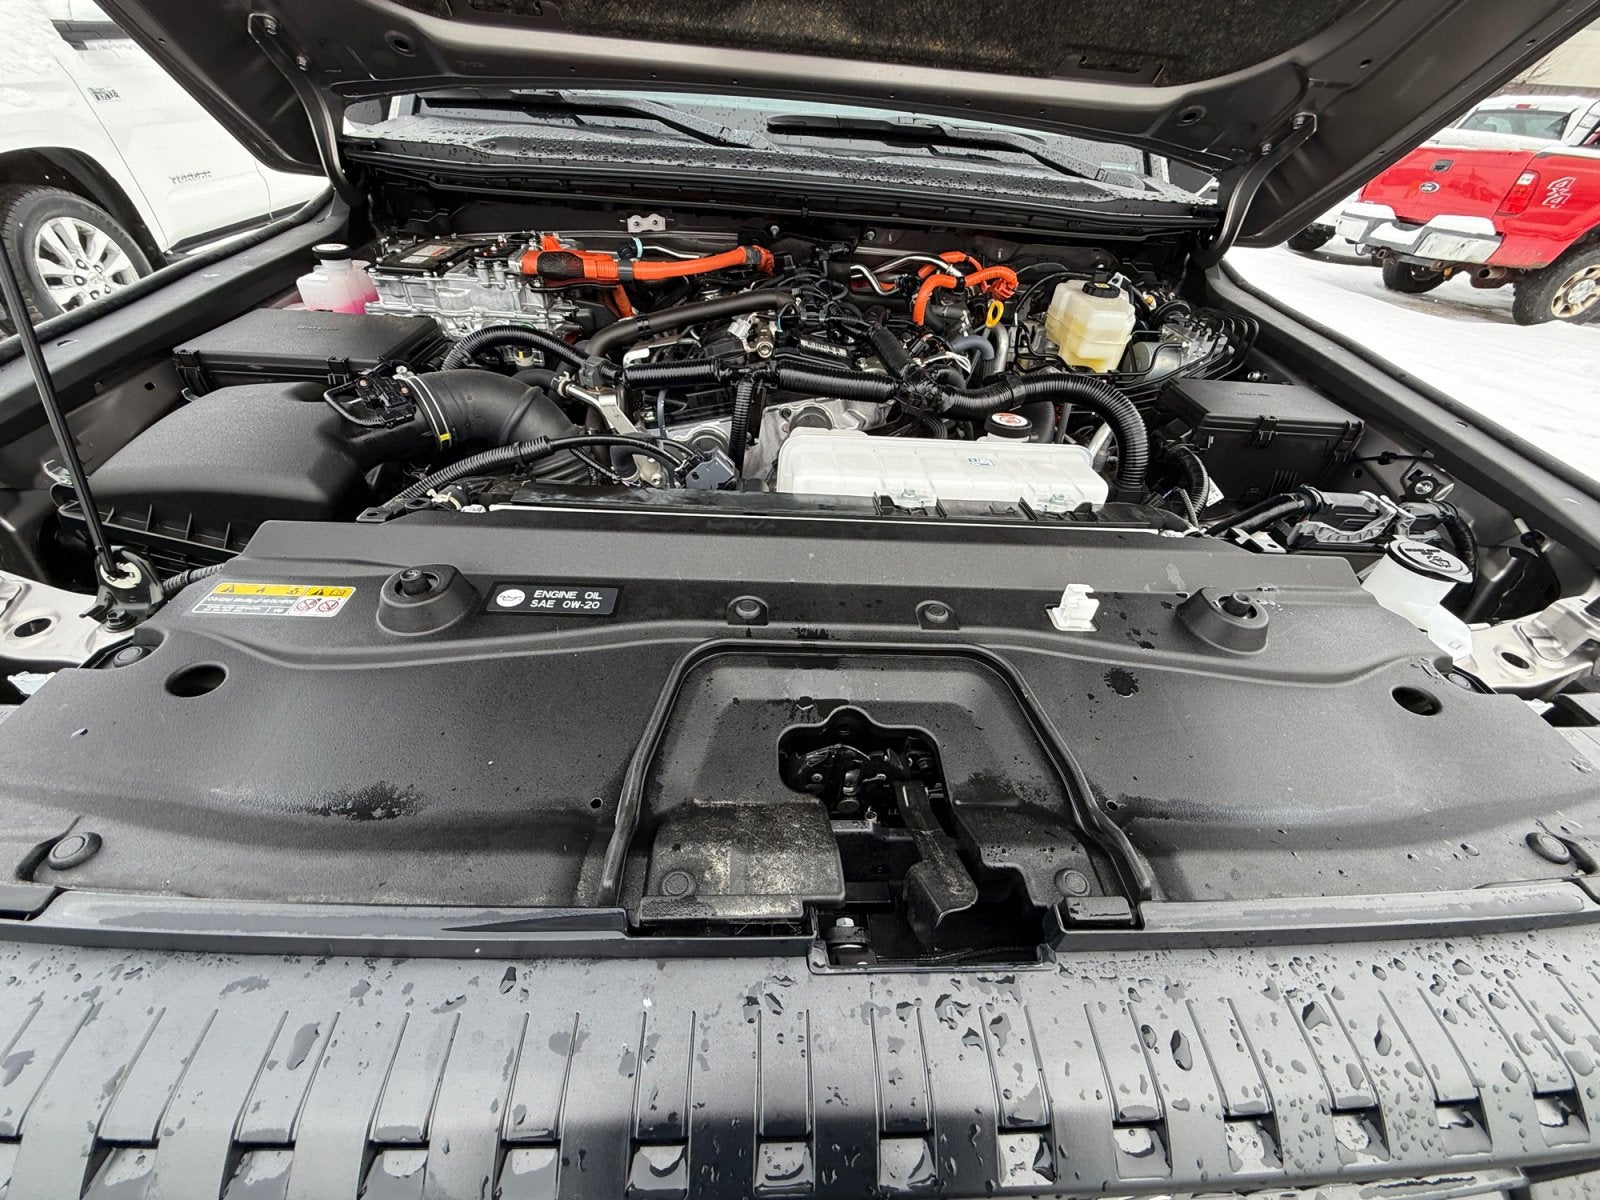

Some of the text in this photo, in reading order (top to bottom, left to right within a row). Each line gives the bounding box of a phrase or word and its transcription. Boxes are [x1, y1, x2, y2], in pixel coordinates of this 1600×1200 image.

[533, 590, 603, 600] ENGINE OIL
[530, 599, 601, 609] SAE 0W-20
